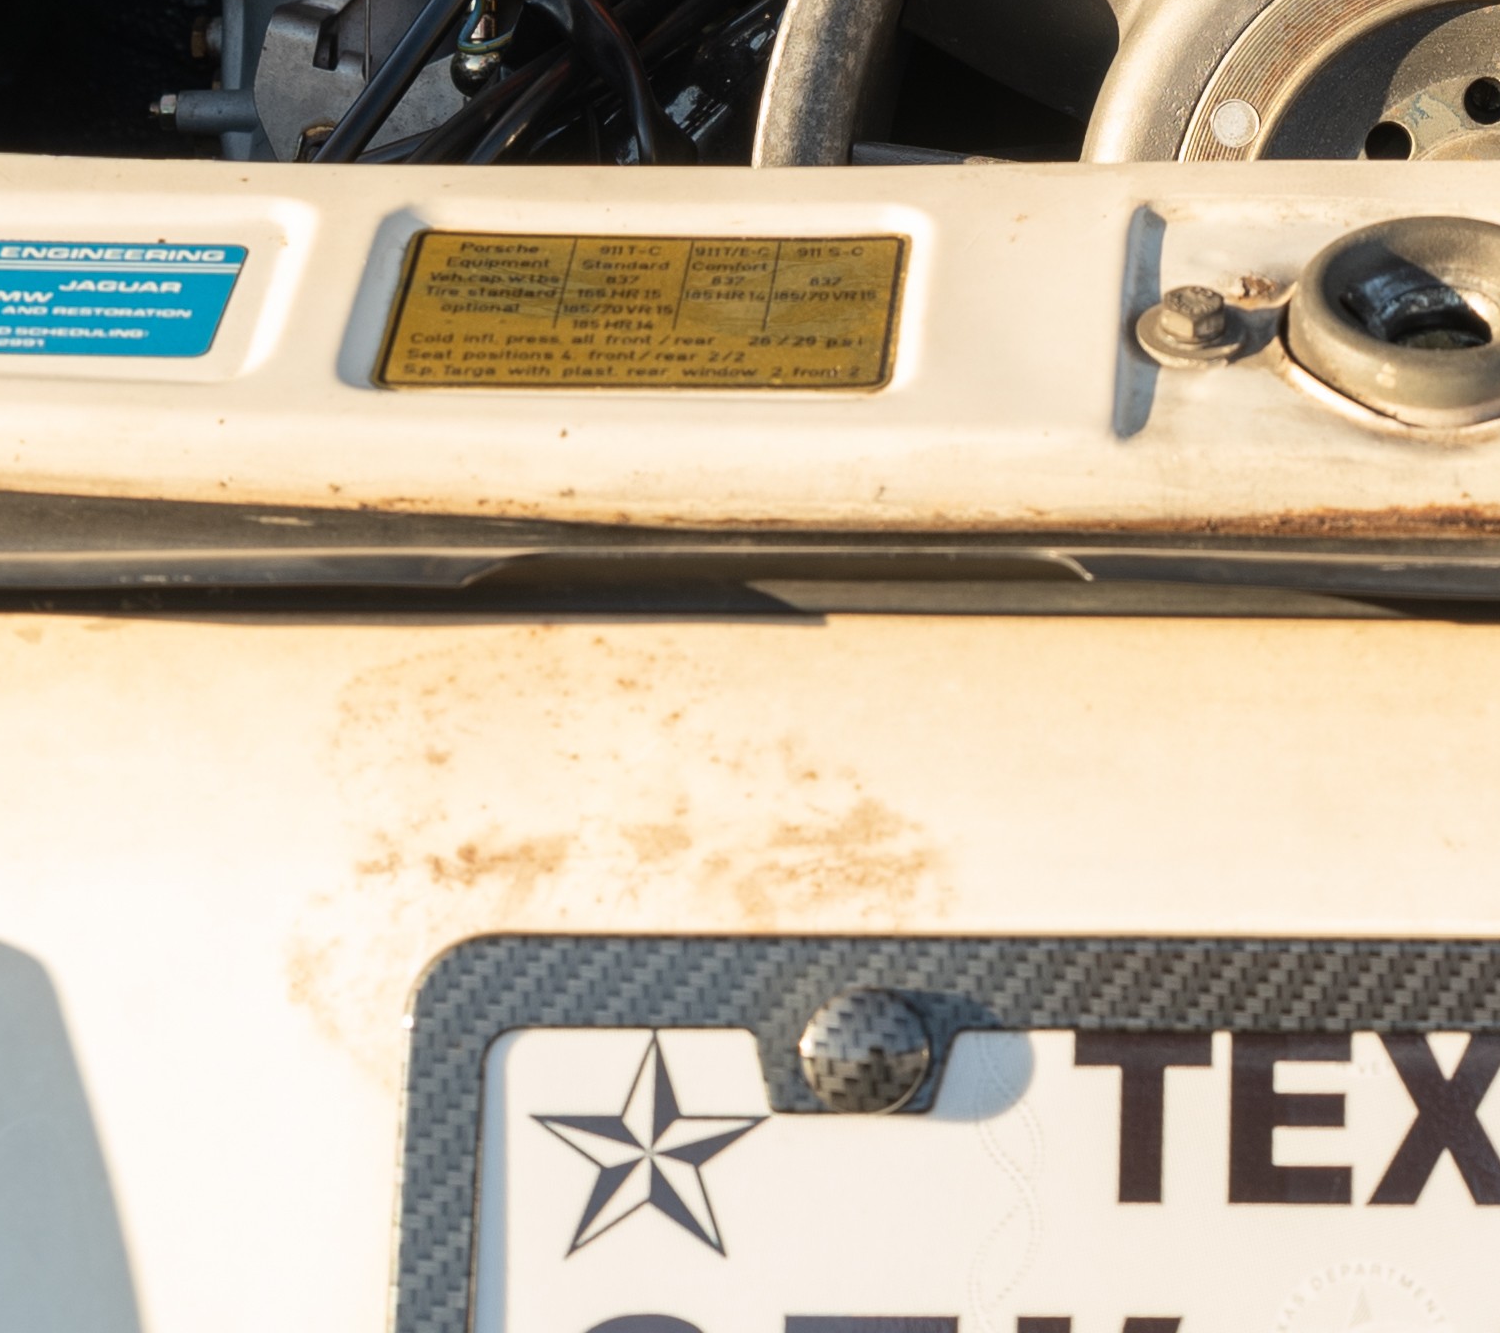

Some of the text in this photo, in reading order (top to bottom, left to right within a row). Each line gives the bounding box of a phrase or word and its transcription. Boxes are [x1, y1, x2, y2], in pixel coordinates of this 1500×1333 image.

[0, 246, 227, 262] ENGINEERING
[461, 242, 540, 254] Porsche
[600, 245, 624, 257] 911
[797, 247, 822, 257] 911
[447, 256, 549, 269] Equipment
[582, 259, 670, 271] Standard
[692, 261, 768, 272] Comfort
[58, 279, 182, 293] JAGUAR
[426, 285, 556, 299] Tire standard
[1, 305, 48, 315] AND
[52, 306, 192, 319] RESTORATION
[440, 303, 521, 315] optional
[410, 333, 716, 346] Cold all front rear
[406, 349, 452, 360] Seat
[462, 349, 554, 363] positions
[444, 364, 496, 378] Targa
[508, 365, 550, 377] with
[626, 367, 669, 377] rear
[682, 367, 759, 377] window
[771, 367, 782, 378] 2
[793, 367, 841, 378] front
